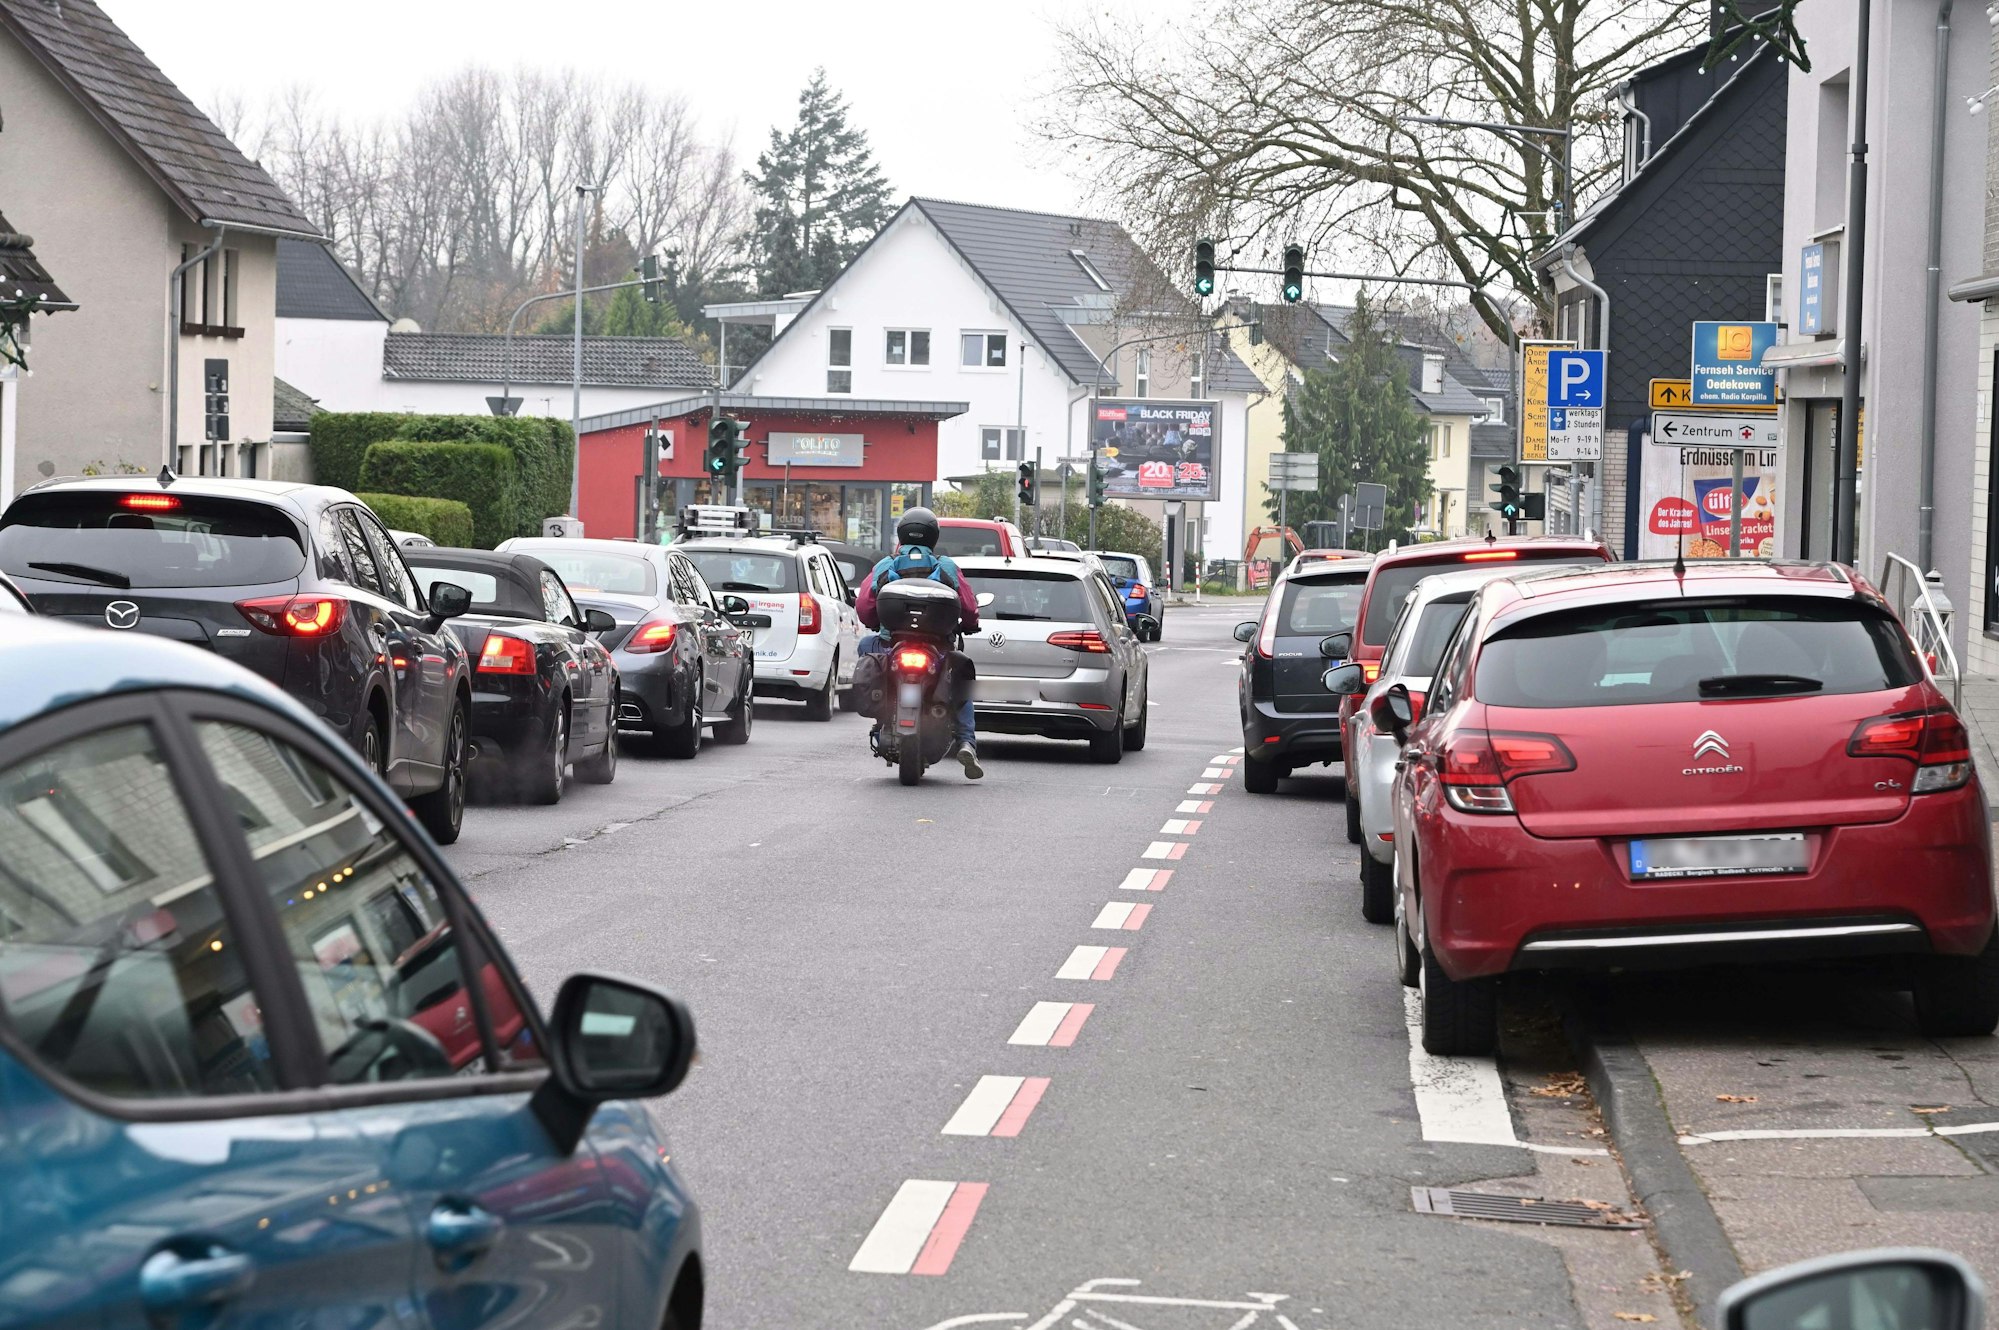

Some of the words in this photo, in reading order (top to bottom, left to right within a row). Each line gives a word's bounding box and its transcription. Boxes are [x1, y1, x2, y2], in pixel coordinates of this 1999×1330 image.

[1694, 364, 1734, 375] Fernseh
[1736, 365, 1774, 376] Service
[1560, 357, 1591, 401] P
[1706, 378, 1762, 390] Oedekoven
[1700, 392, 1719, 400] ehem.
[1741, 393, 1767, 402] Korpilla
[1140, 409, 1174, 419] BLACK
[1176, 410, 1212, 420] FRIDAY
[1568, 409, 1599, 418] werktags
[1681, 424, 1733, 437] Zentrum
[1550, 435, 1570, 444] Mo-Fr
[1577, 435, 1592, 443] 9-19
[1594, 435, 1599, 443] h
[1550, 448, 1559, 456] Sa
[1576, 447, 1592, 455] 9-14
[1594, 447, 1599, 455] h
[1657, 507, 1669, 517] Der
[1669, 507, 1694, 517] Kracher
[1657, 519, 1669, 528] des
[1669, 519, 1693, 529] Jahres!
[1706, 525, 1730, 536] Linse
[1682, 764, 1744, 776] CITROËN
[1873, 778, 1903, 791] C4
[1687, 869, 1715, 877] Bergisch
